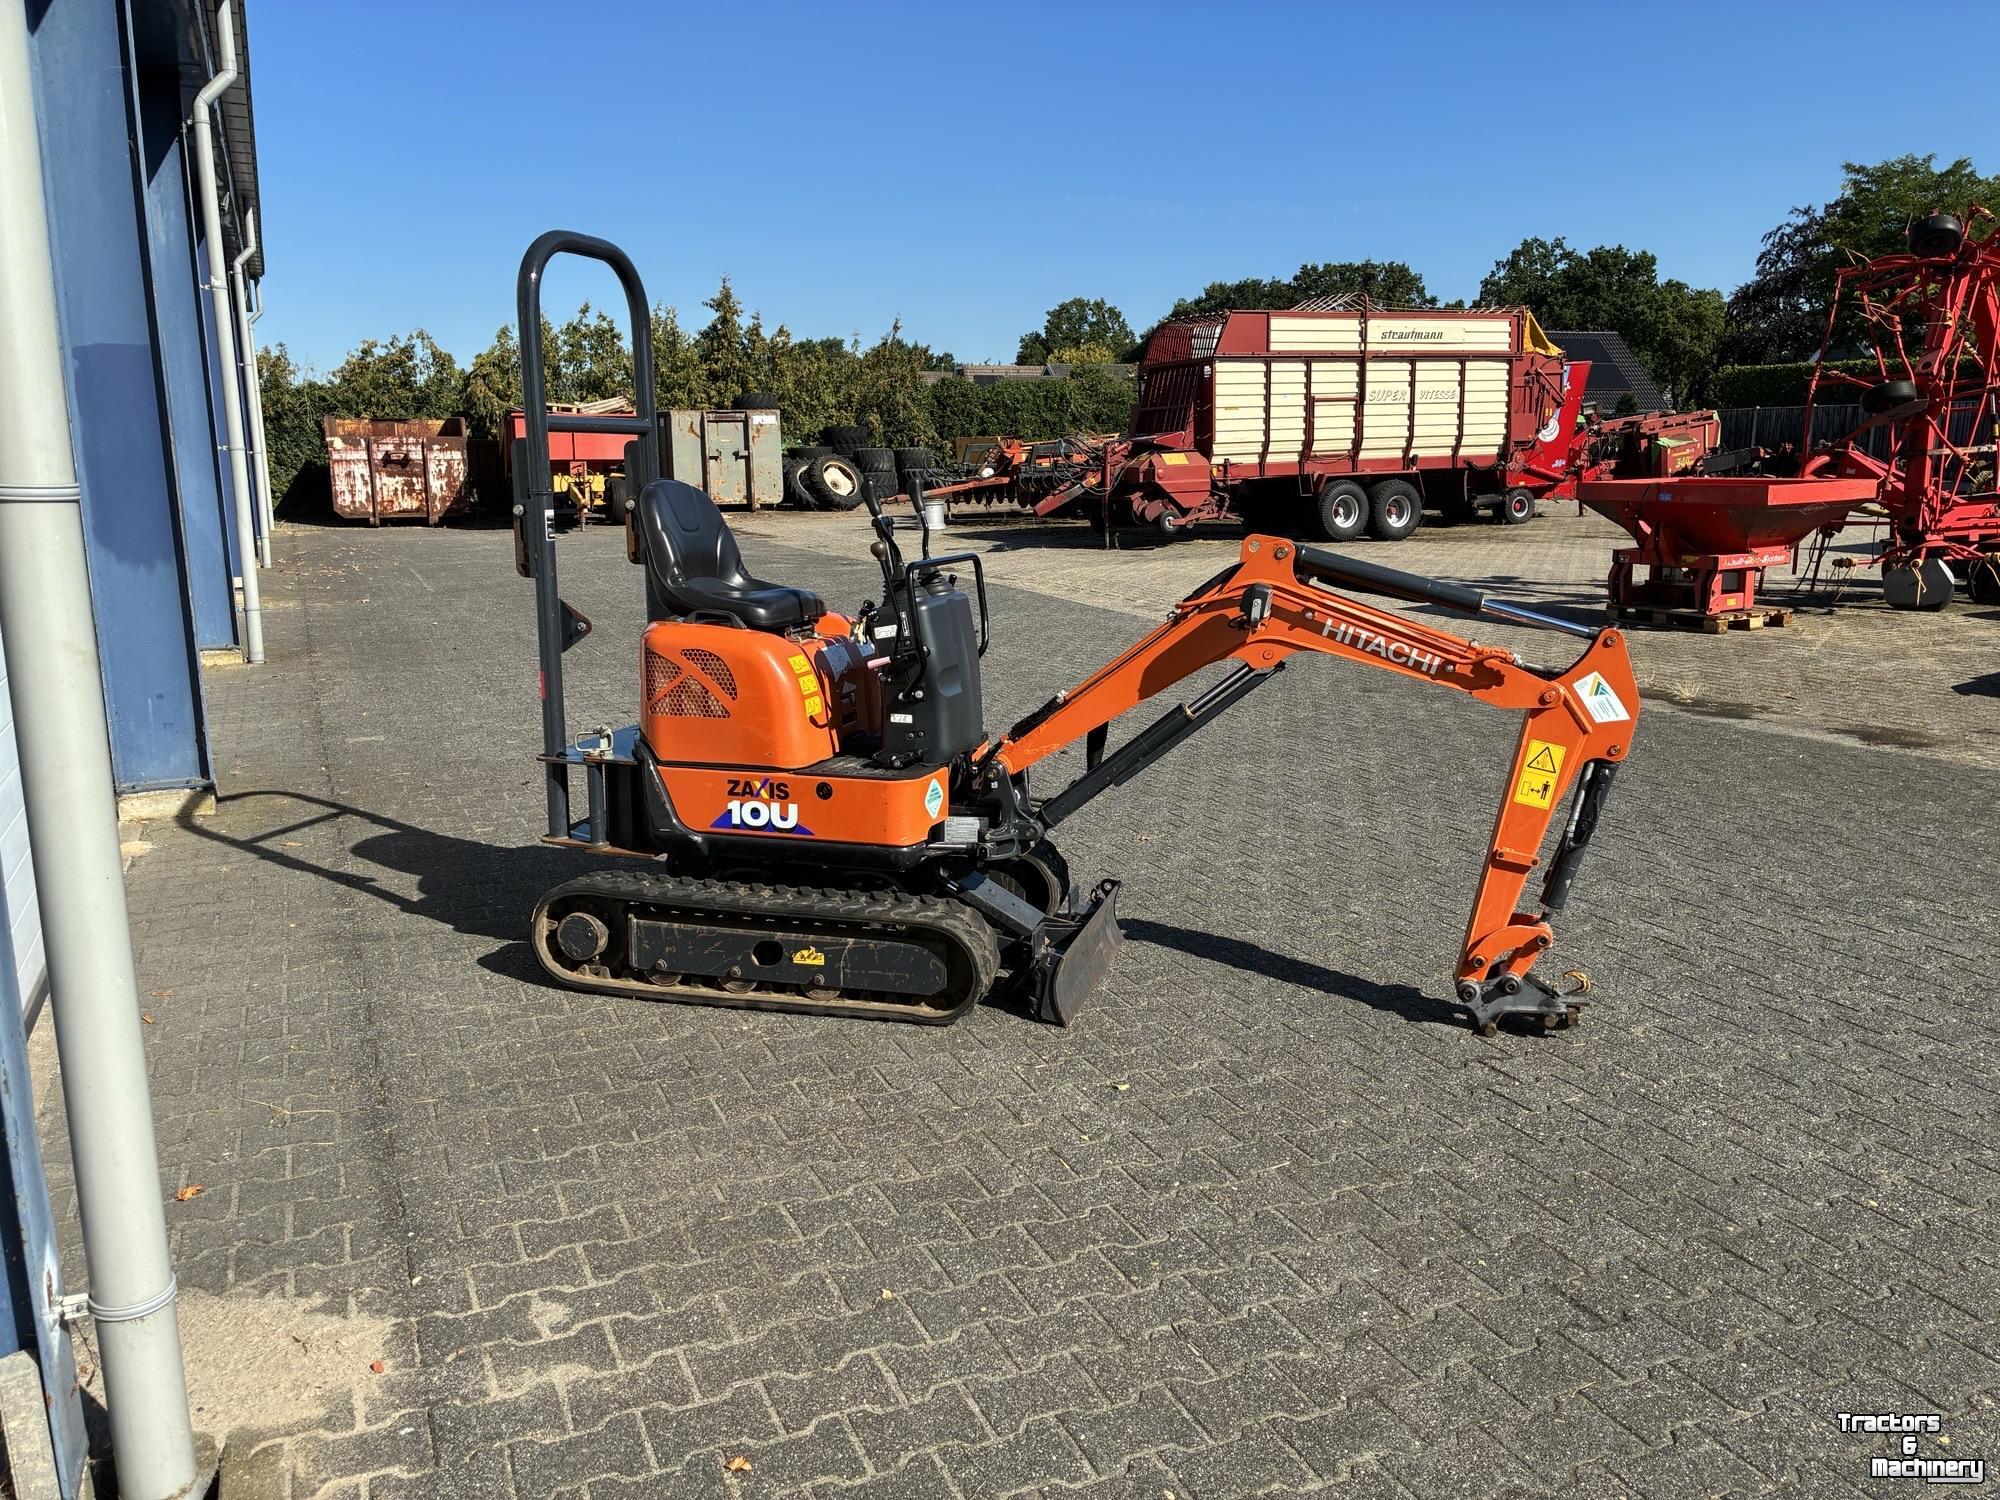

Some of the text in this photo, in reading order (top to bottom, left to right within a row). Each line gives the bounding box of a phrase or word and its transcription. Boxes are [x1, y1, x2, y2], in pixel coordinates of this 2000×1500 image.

[1369, 389, 1456, 401] SUPER VITESSE
[1321, 617, 1441, 675] HITACHI
[727, 778, 790, 801] ZAXIS
[727, 799, 799, 833] 10U
